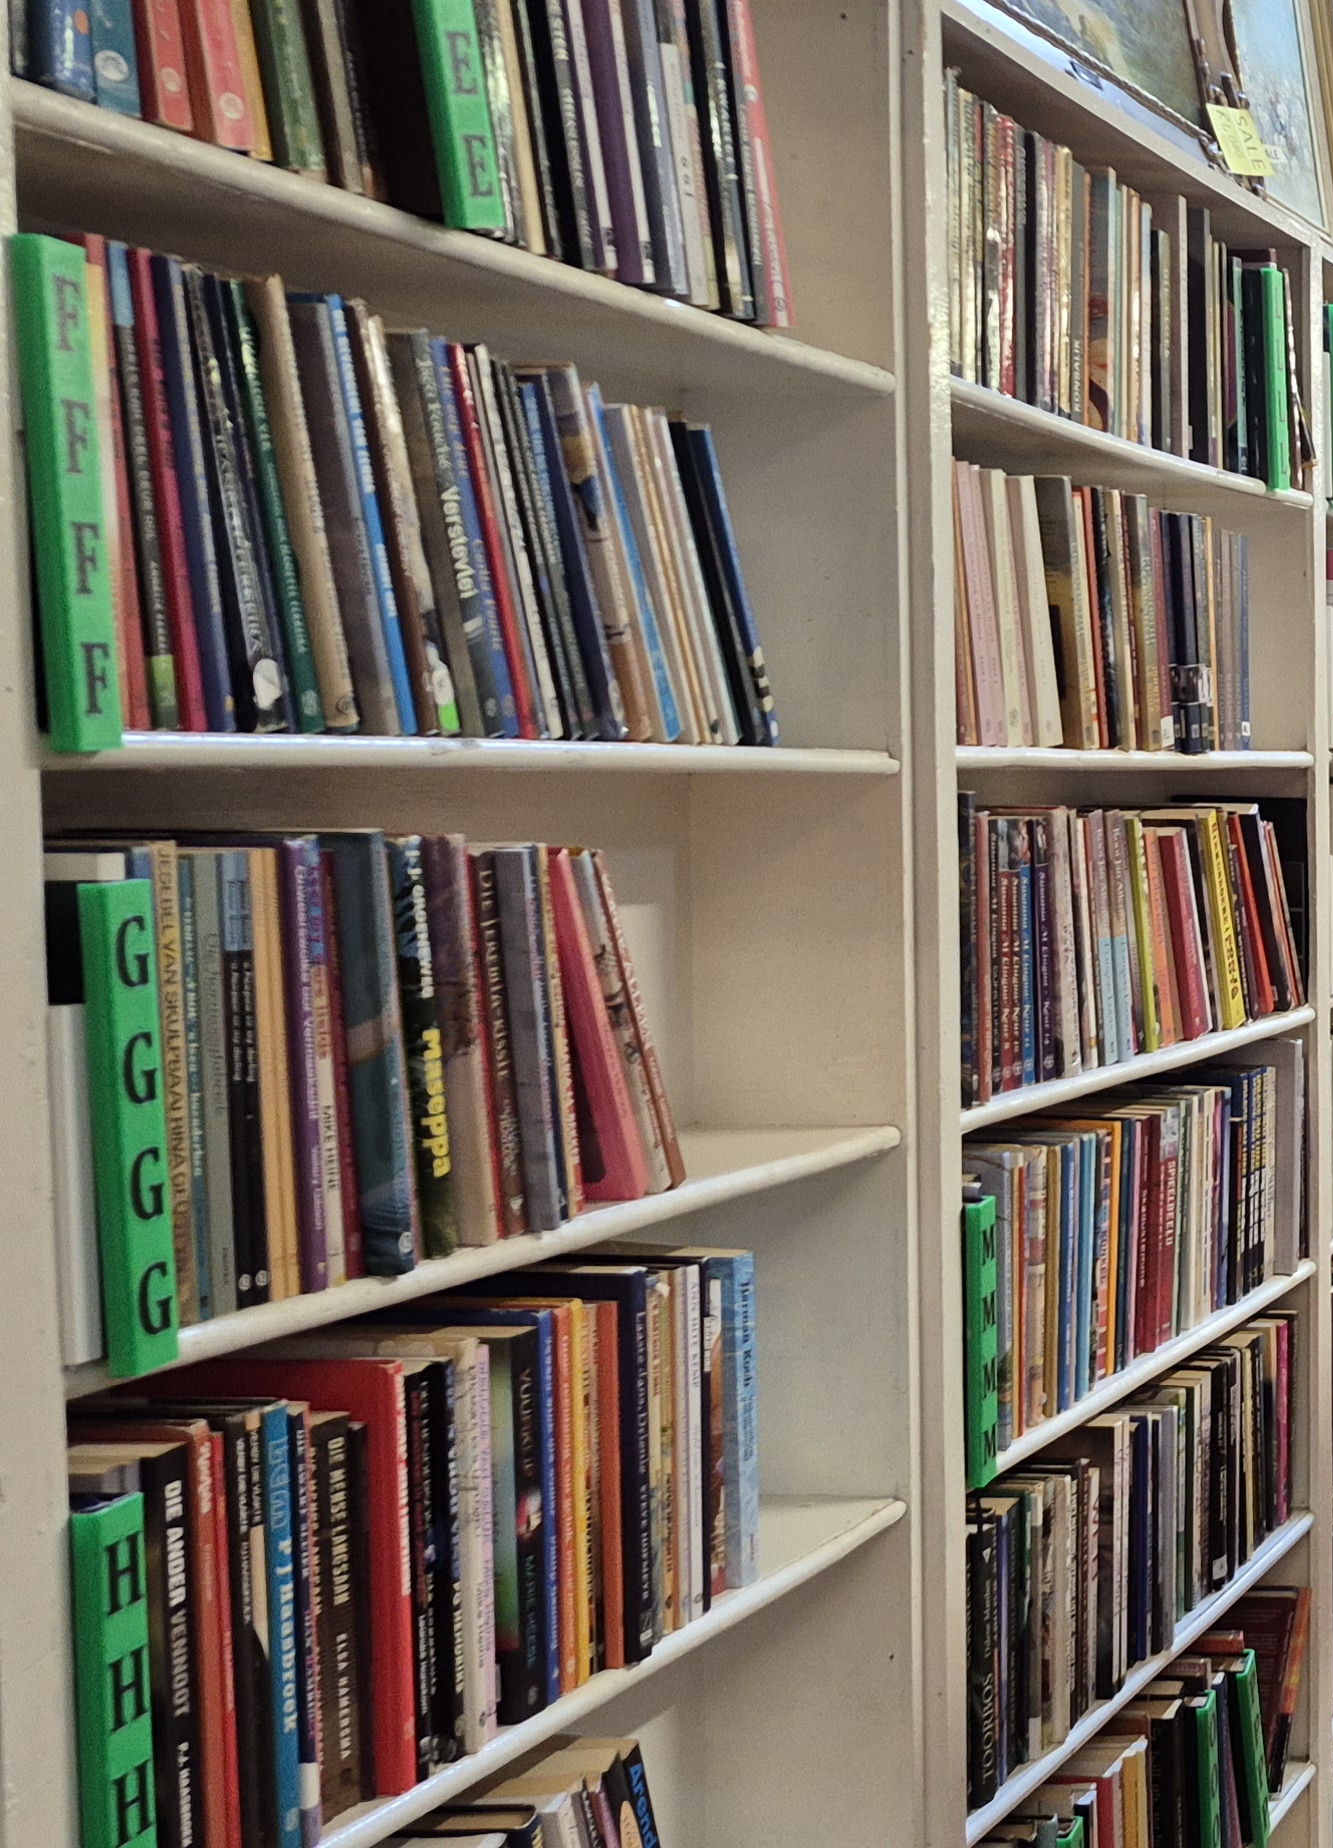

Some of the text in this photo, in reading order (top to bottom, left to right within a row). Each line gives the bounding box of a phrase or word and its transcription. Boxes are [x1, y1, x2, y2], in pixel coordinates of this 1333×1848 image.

[447, 32, 494, 197] E E
[1234, 115, 1267, 170] SALE
[54, 275, 110, 714] F F F F
[154, 847, 177, 934] JESEBEL
[159, 936, 179, 983] VAN
[115, 916, 173, 1335] G G G G
[741, 1348, 753, 1387] Koch
[162, 1480, 193, 1717] DIE ANDER VENNOOT
[275, 1539, 302, 1733] P J Haasbroek
[523, 1554, 536, 1609] MARIE
[108, 1535, 153, 1847] H H H
[976, 1672, 1000, 1784] TOORBOS
